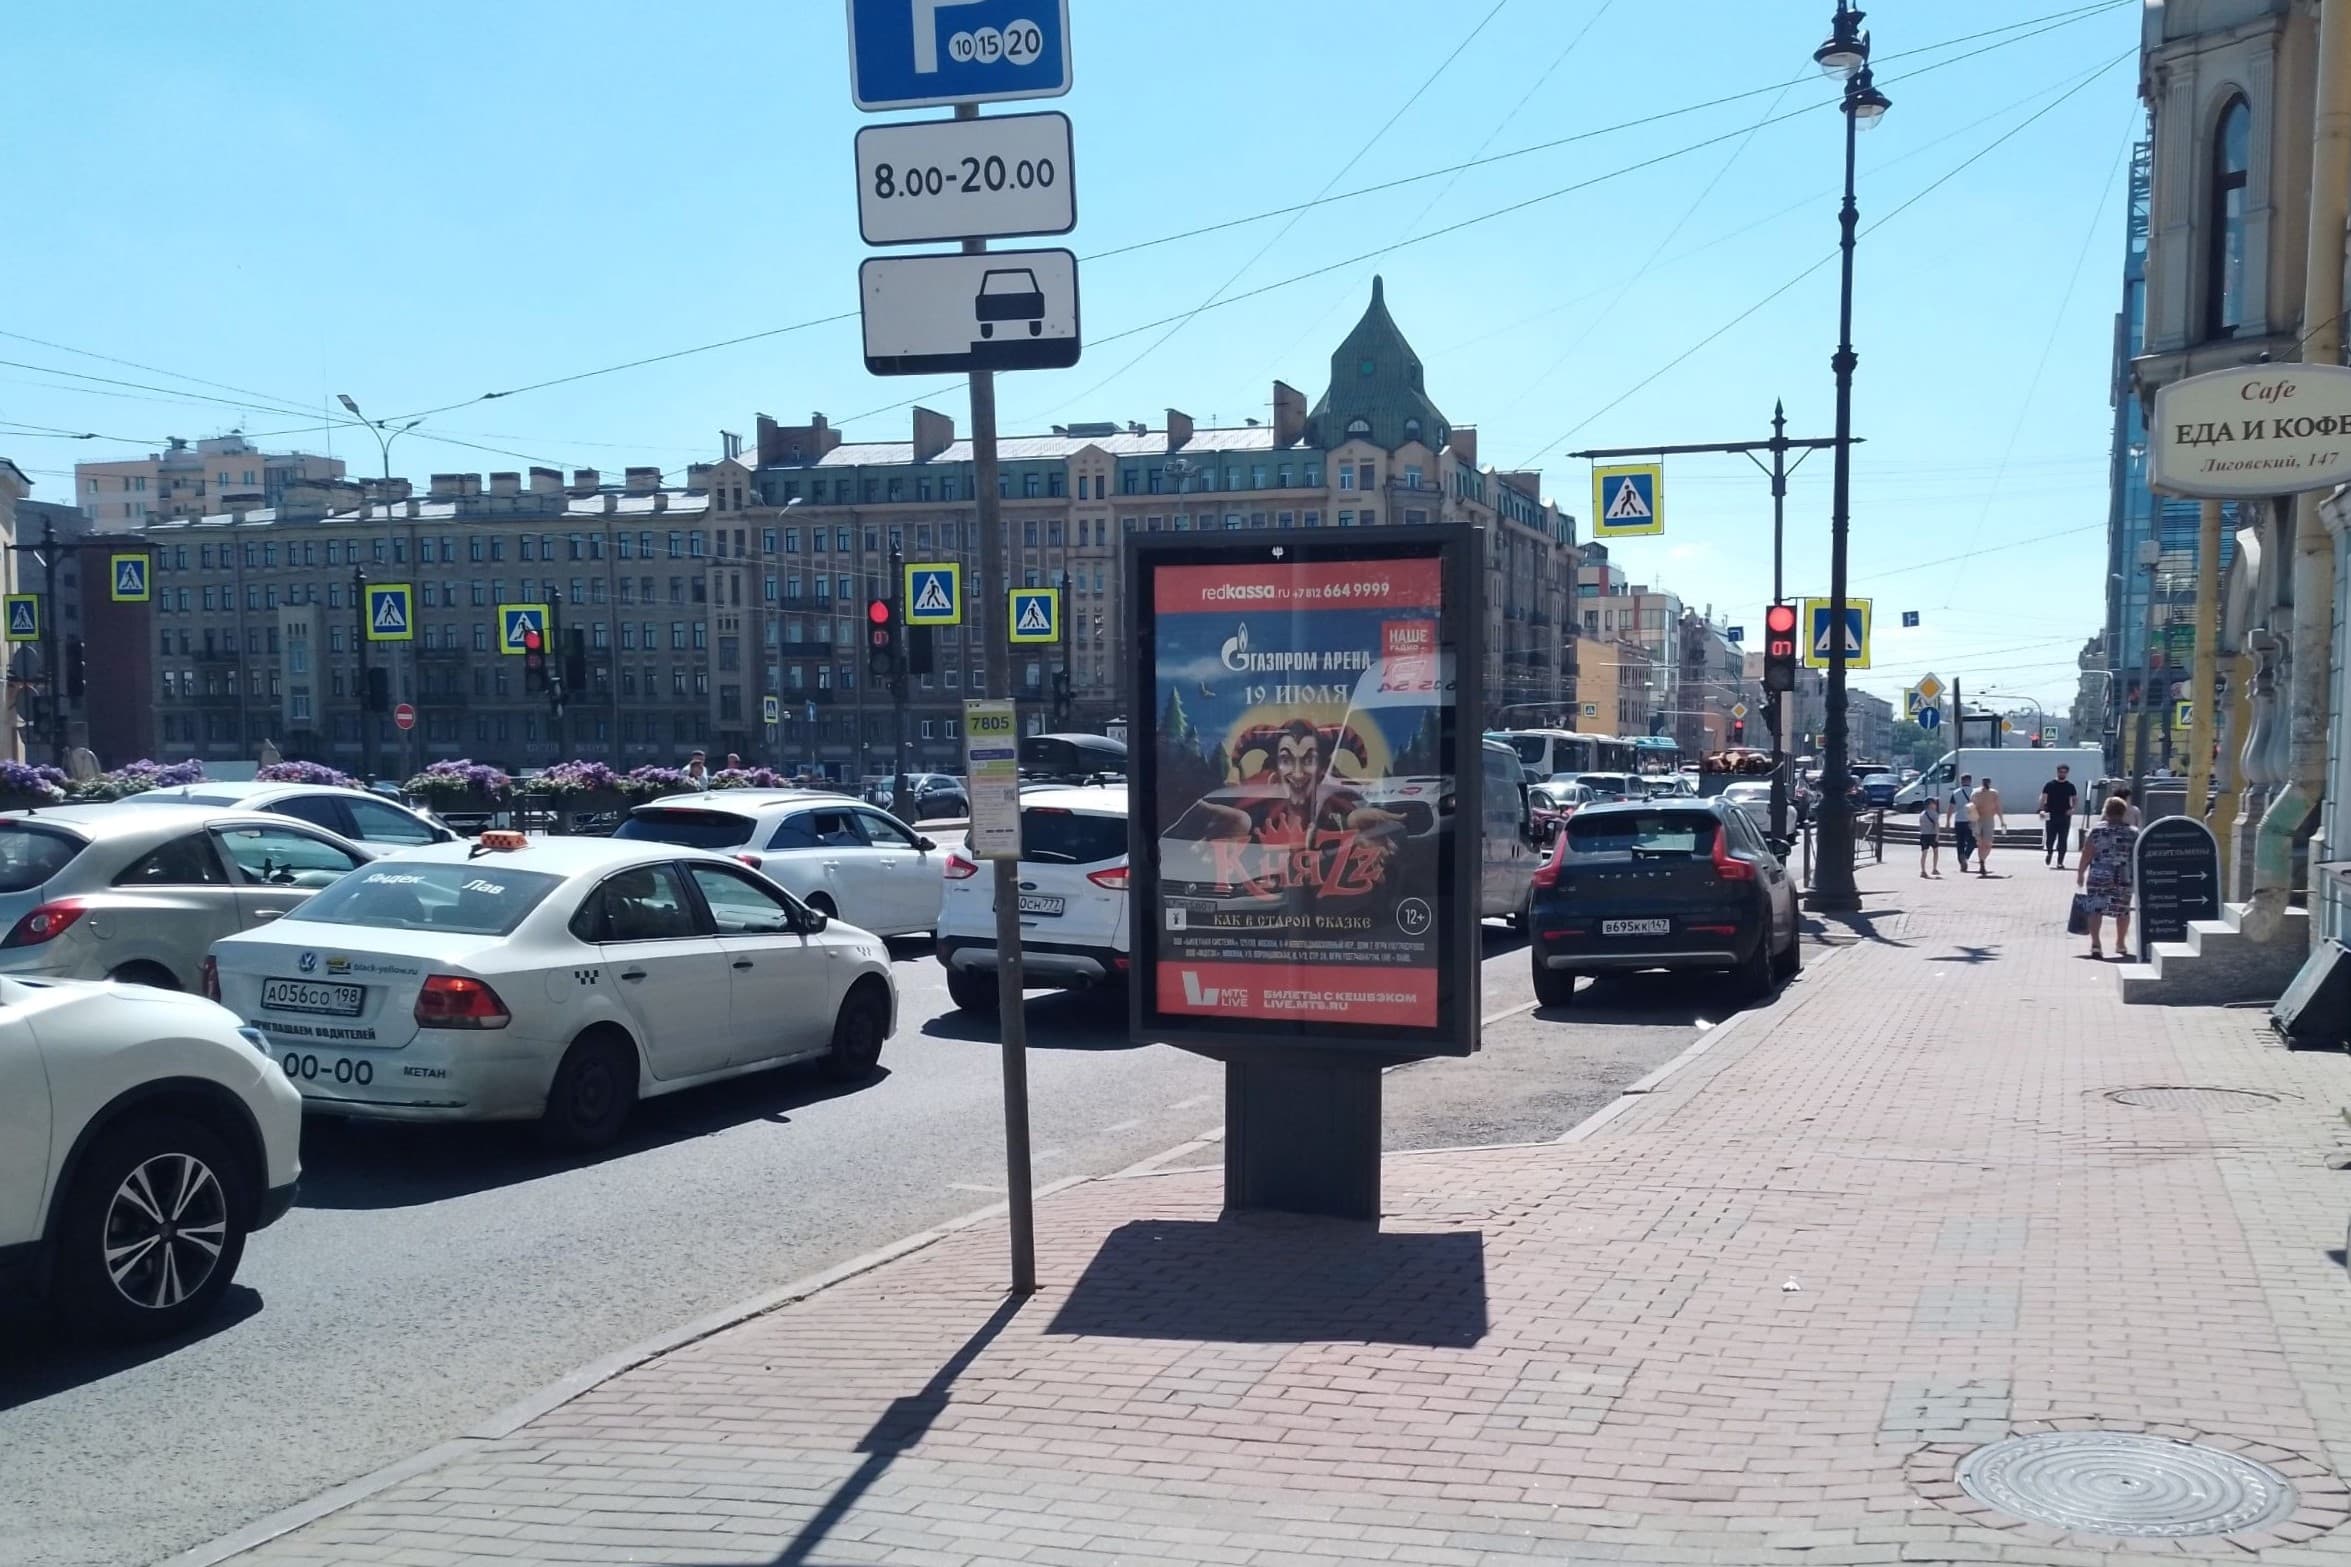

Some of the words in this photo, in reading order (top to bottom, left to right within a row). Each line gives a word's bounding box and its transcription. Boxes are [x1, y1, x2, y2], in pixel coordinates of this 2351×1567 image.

[955, 39, 972, 56] 10
[978, 35, 999, 56] 15
[1008, 28, 1041, 56] 20
[875, 155, 1055, 199] 8.00-20.00
[2241, 380, 2297, 404] Cafe
[2175, 421, 2236, 448] ЕДА
[2241, 420, 2265, 441] И
[2272, 414, 2351, 439] КОФЕ
[2200, 455, 2301, 473] Лиговский,
[2307, 452, 2340, 467] 147
[1323, 584, 1350, 598] 664
[1353, 582, 1390, 597] 9999
[1389, 629, 1428, 643] НАШЕ
[1772, 640, 1792, 656] 07
[1251, 652, 1318, 672] ГАЗПРОМ
[1323, 651, 1371, 670] АРЕНА
[1246, 686, 1266, 705] 19
[1276, 684, 1350, 704] ИЮЛЯ
[969, 716, 1010, 731] 7805
[1214, 914, 1241, 926] КАК
[1405, 909, 1425, 925] 12+
[1650, 919, 1667, 931] 147
[267, 983, 330, 1006] А056СО
[334, 987, 358, 1002] 198
[1264, 990, 1322, 1000] БИЛЕТЫ
[1221, 998, 1248, 1008] LIVE
[316, 1027, 376, 1041] ВОДИТЕЛЕЙ
[403, 1066, 447, 1079] МЕТАН
